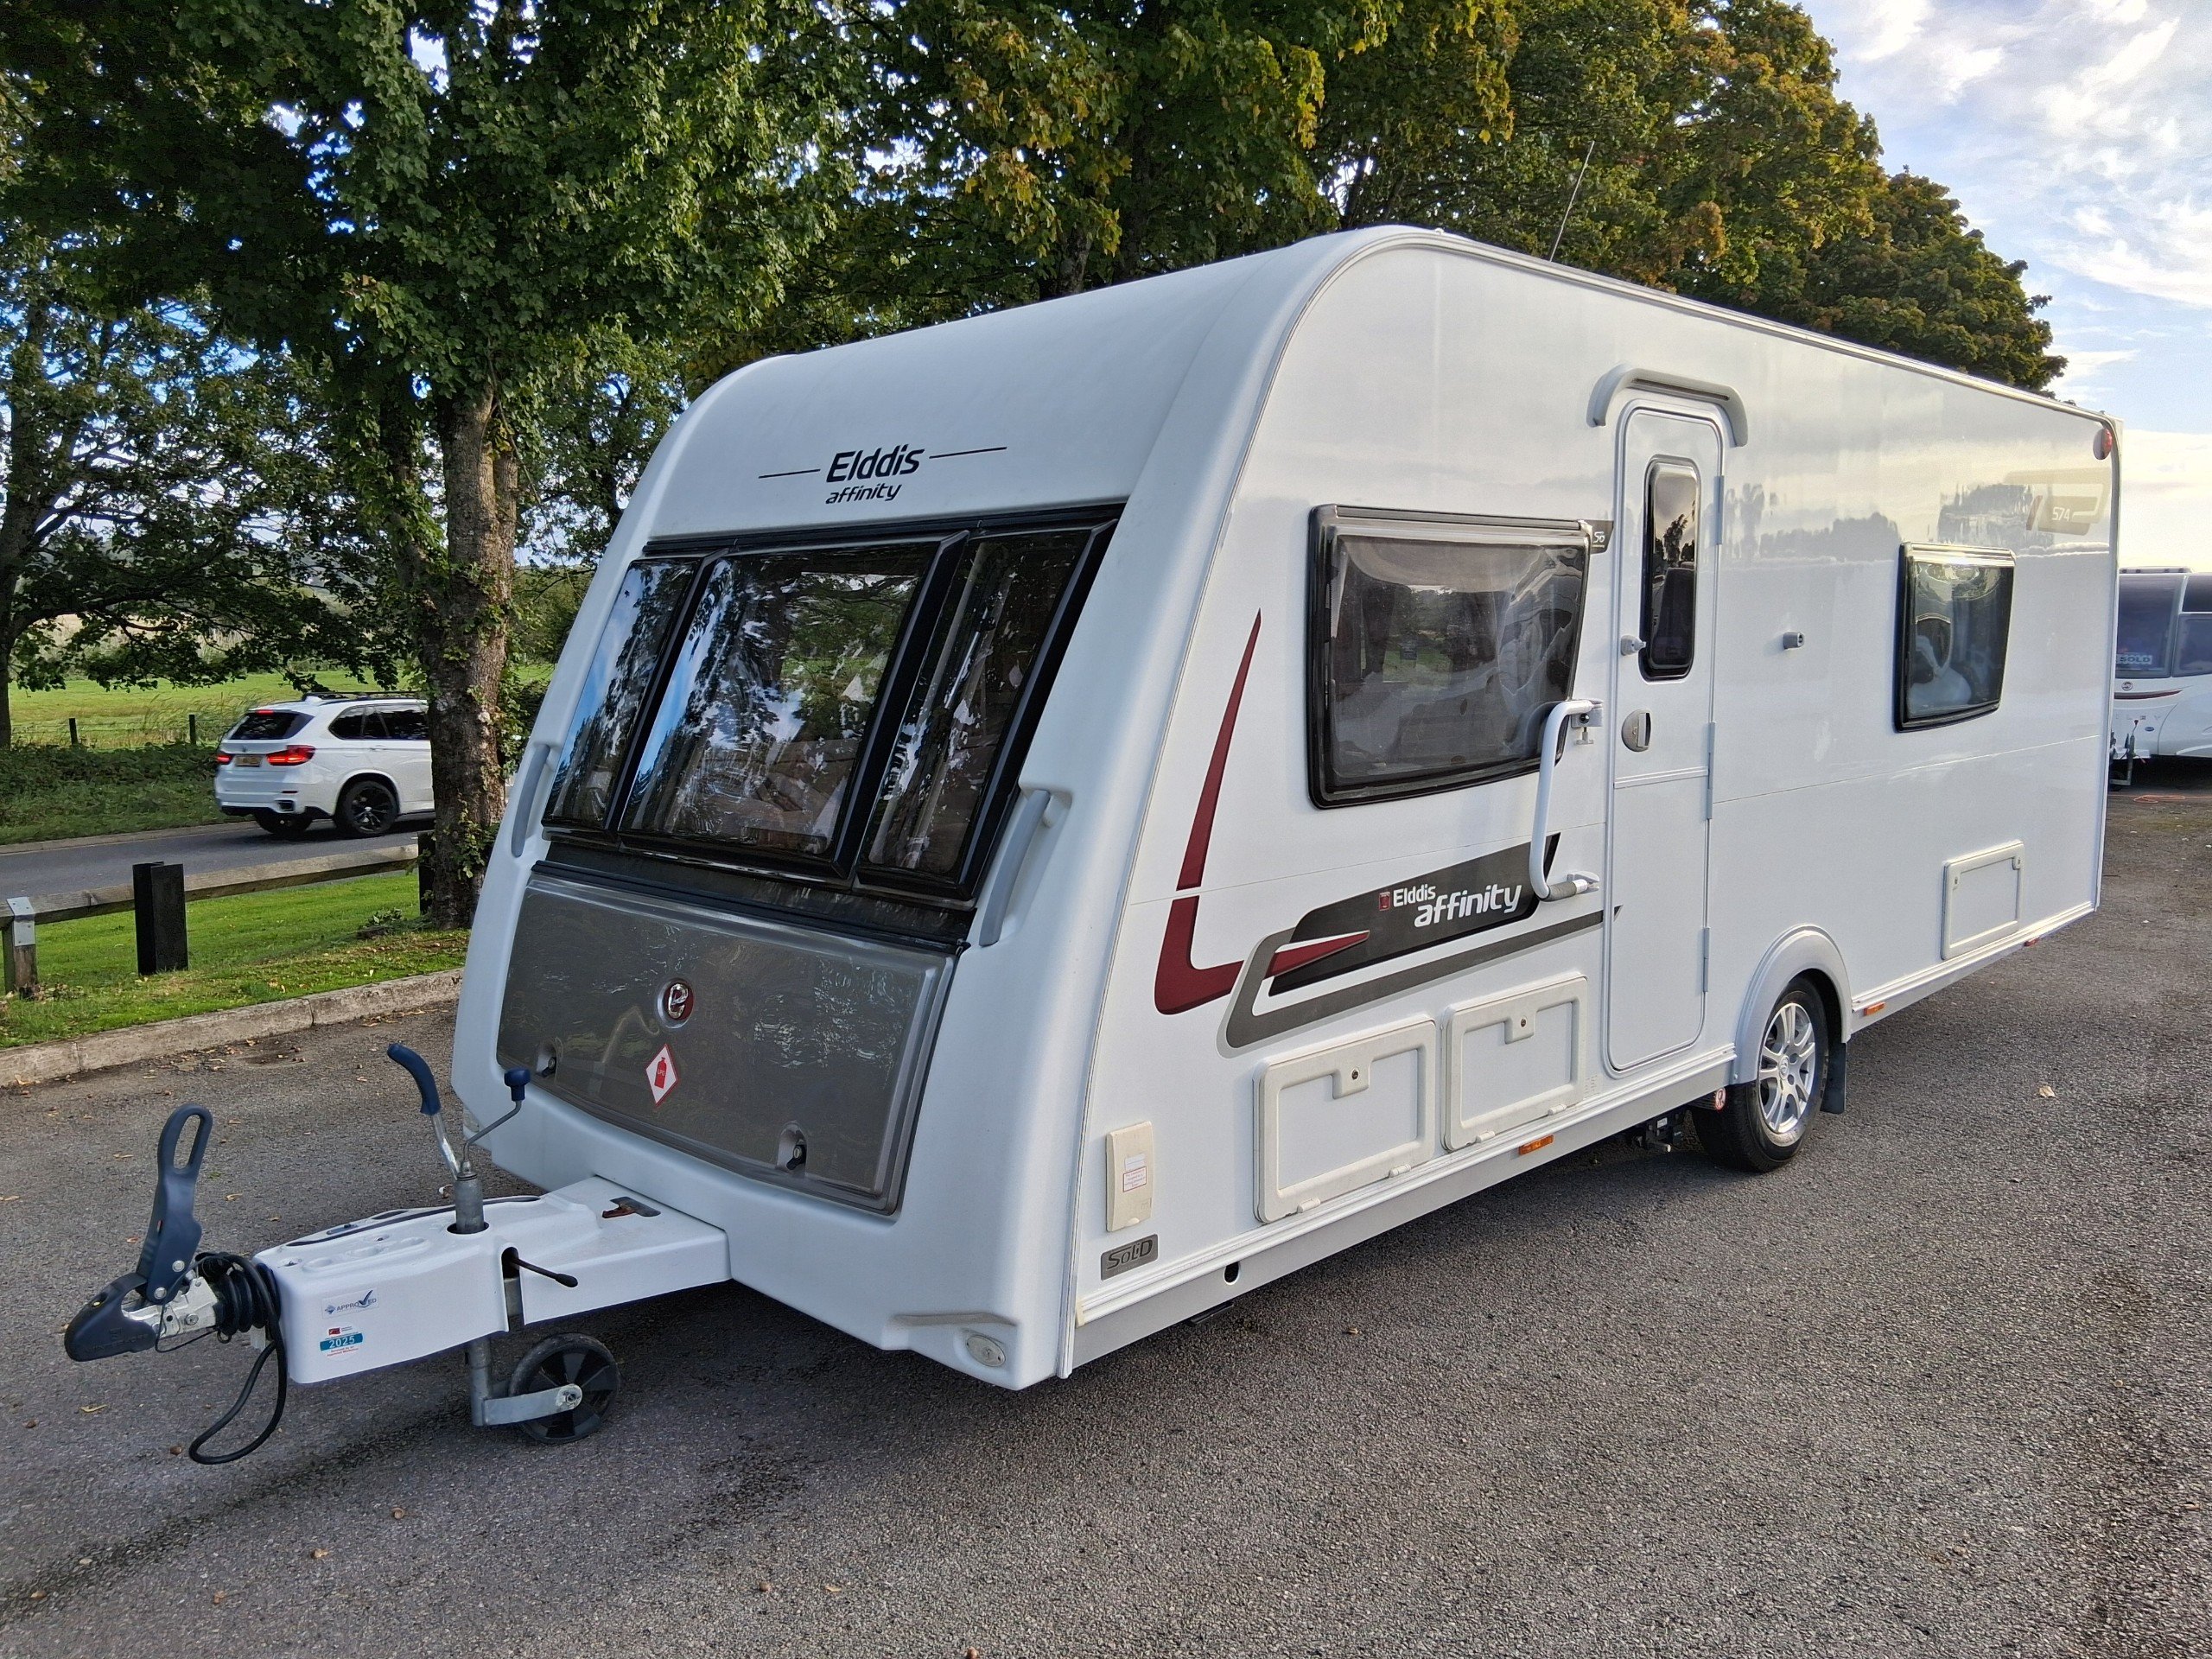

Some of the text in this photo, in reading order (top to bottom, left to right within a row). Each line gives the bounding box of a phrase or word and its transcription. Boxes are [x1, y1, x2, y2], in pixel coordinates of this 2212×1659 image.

[826, 444, 925, 483] Elddis
[825, 483, 902, 505] affinity
[2052, 506, 2070, 522] 574
[1393, 883, 1436, 907] Elddis
[1414, 883, 1522, 928] affinity
[328, 1335, 355, 1349] 2025
